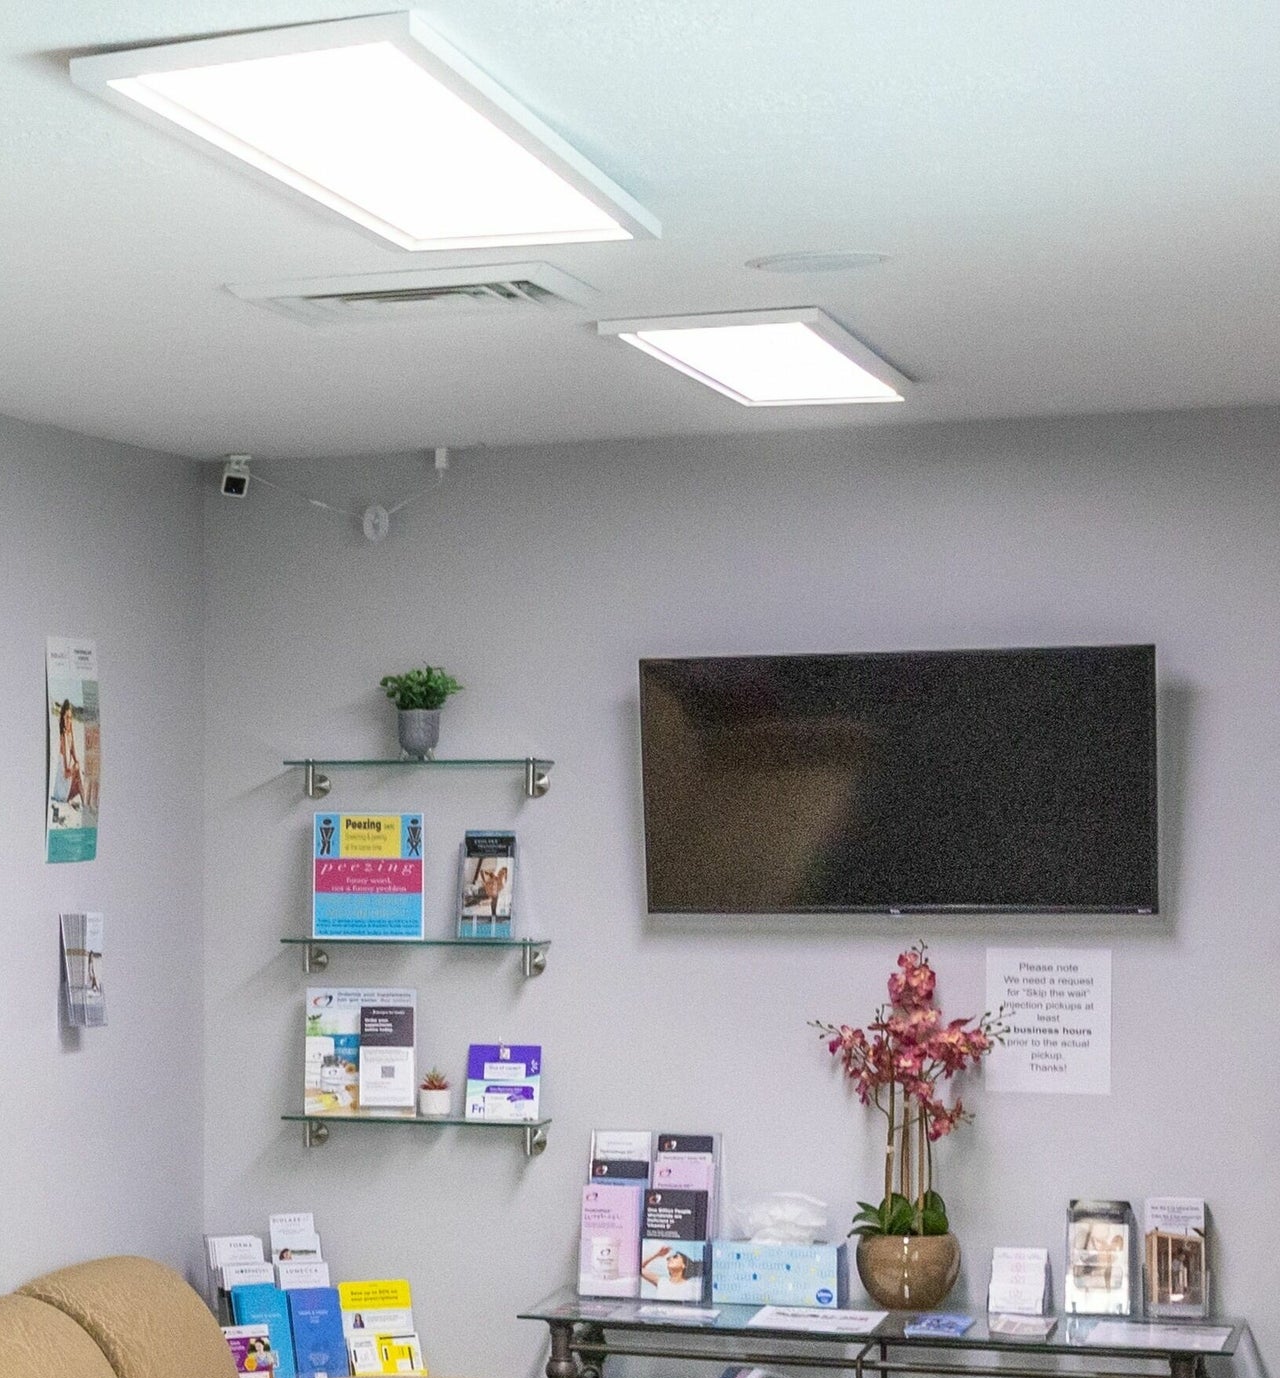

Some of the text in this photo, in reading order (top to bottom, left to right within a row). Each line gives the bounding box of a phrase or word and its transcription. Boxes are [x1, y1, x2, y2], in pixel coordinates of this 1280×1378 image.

[345, 818, 382, 832] Peezing
[320, 860, 415, 876] peezing
[346, 877, 368, 885] funny
[352, 884, 373, 892] funny
[375, 884, 407, 892] problem
[1019, 963, 1079, 972] Please note
[1003, 975, 1095, 987] We need a request
[1007, 988, 1019, 997] for
[1049, 988, 1065, 997] the
[1045, 1001, 1082, 1011] pickups
[1084, 1002, 1095, 1010] at
[1036, 1014, 1061, 1023] least
[1013, 1026, 1060, 1035] business
[1062, 1026, 1092, 1035] hours
[1006, 1038, 1090, 1048] prior to the actual
[1030, 1051, 1063, 1061] pickup
[1030, 1062, 1068, 1073] Thanks!
